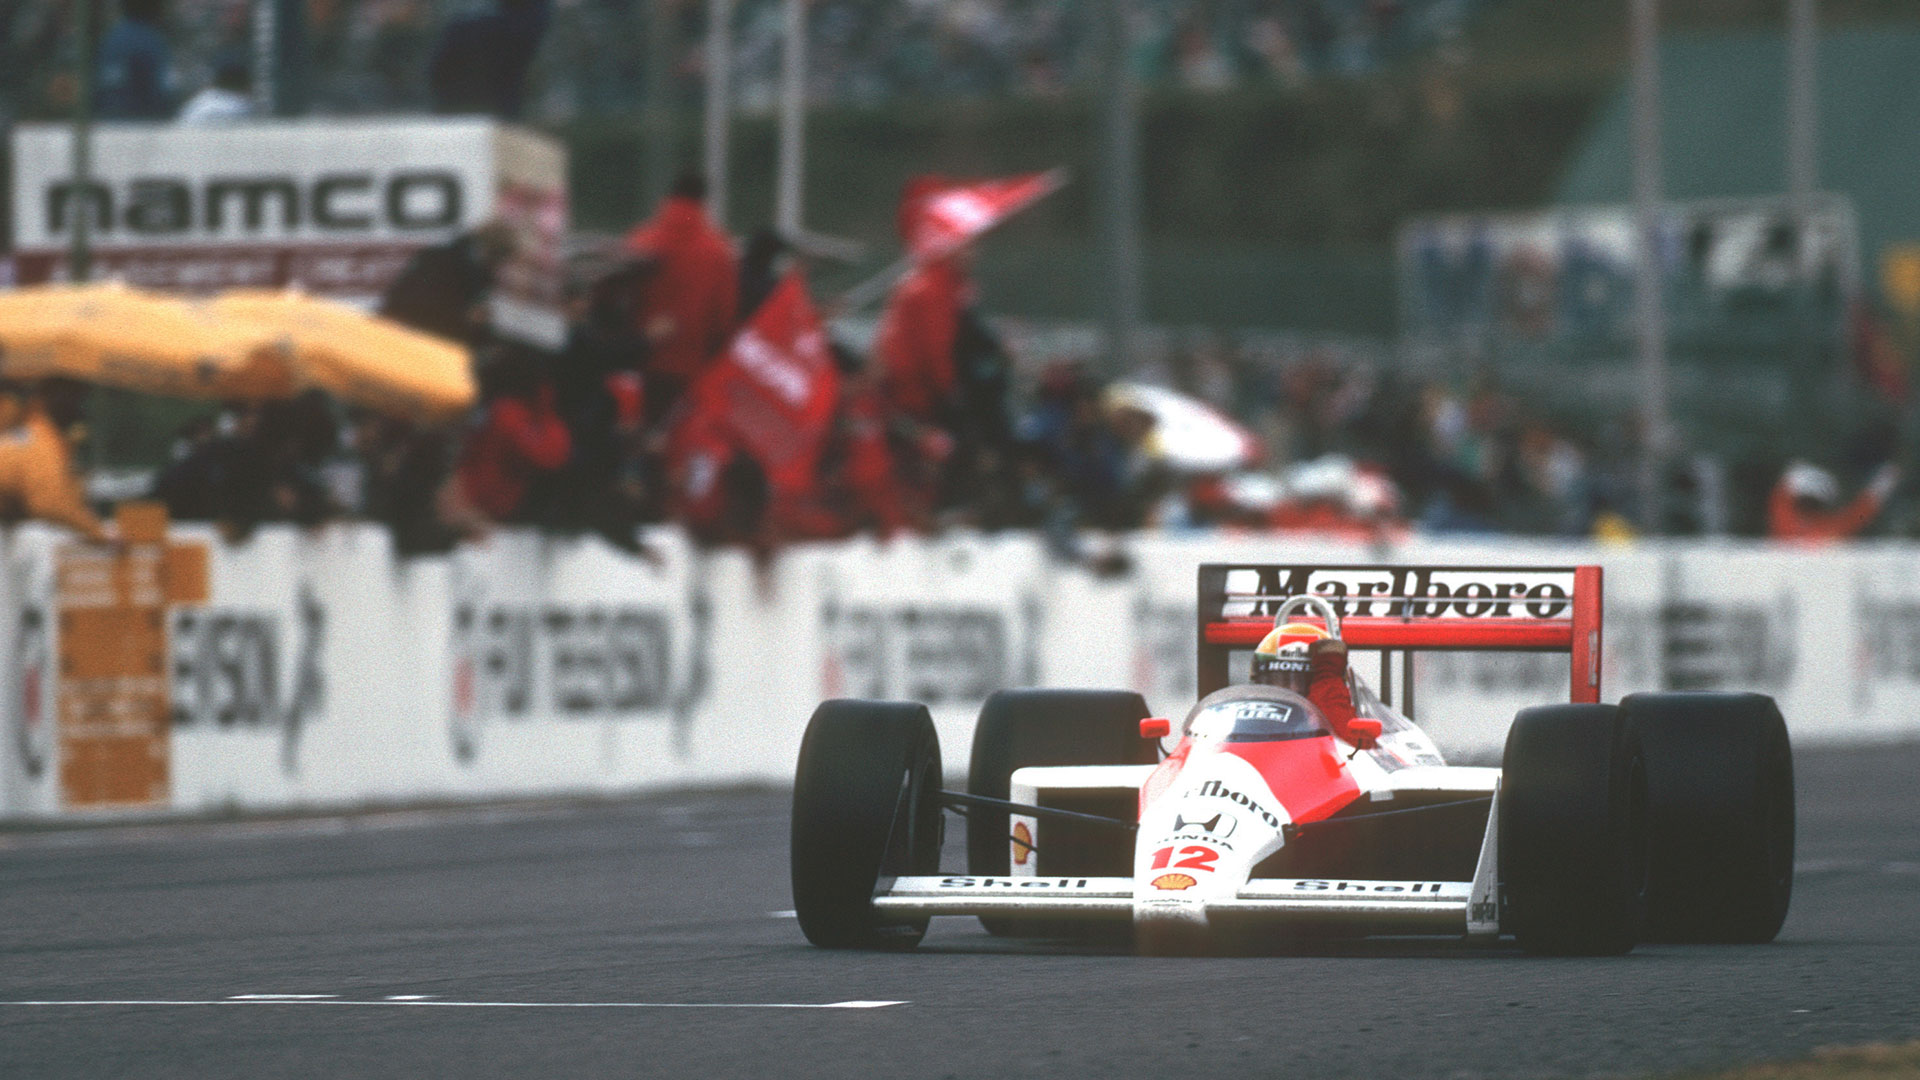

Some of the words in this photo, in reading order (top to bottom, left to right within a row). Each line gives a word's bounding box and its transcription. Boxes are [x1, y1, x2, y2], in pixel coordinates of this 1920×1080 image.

[46, 170, 461, 235] namco
[1249, 567, 1568, 617] Marlboro
[1150, 845, 1220, 873] 12
[939, 877, 1088, 889] Shell
[1292, 879, 1442, 893] Shell
